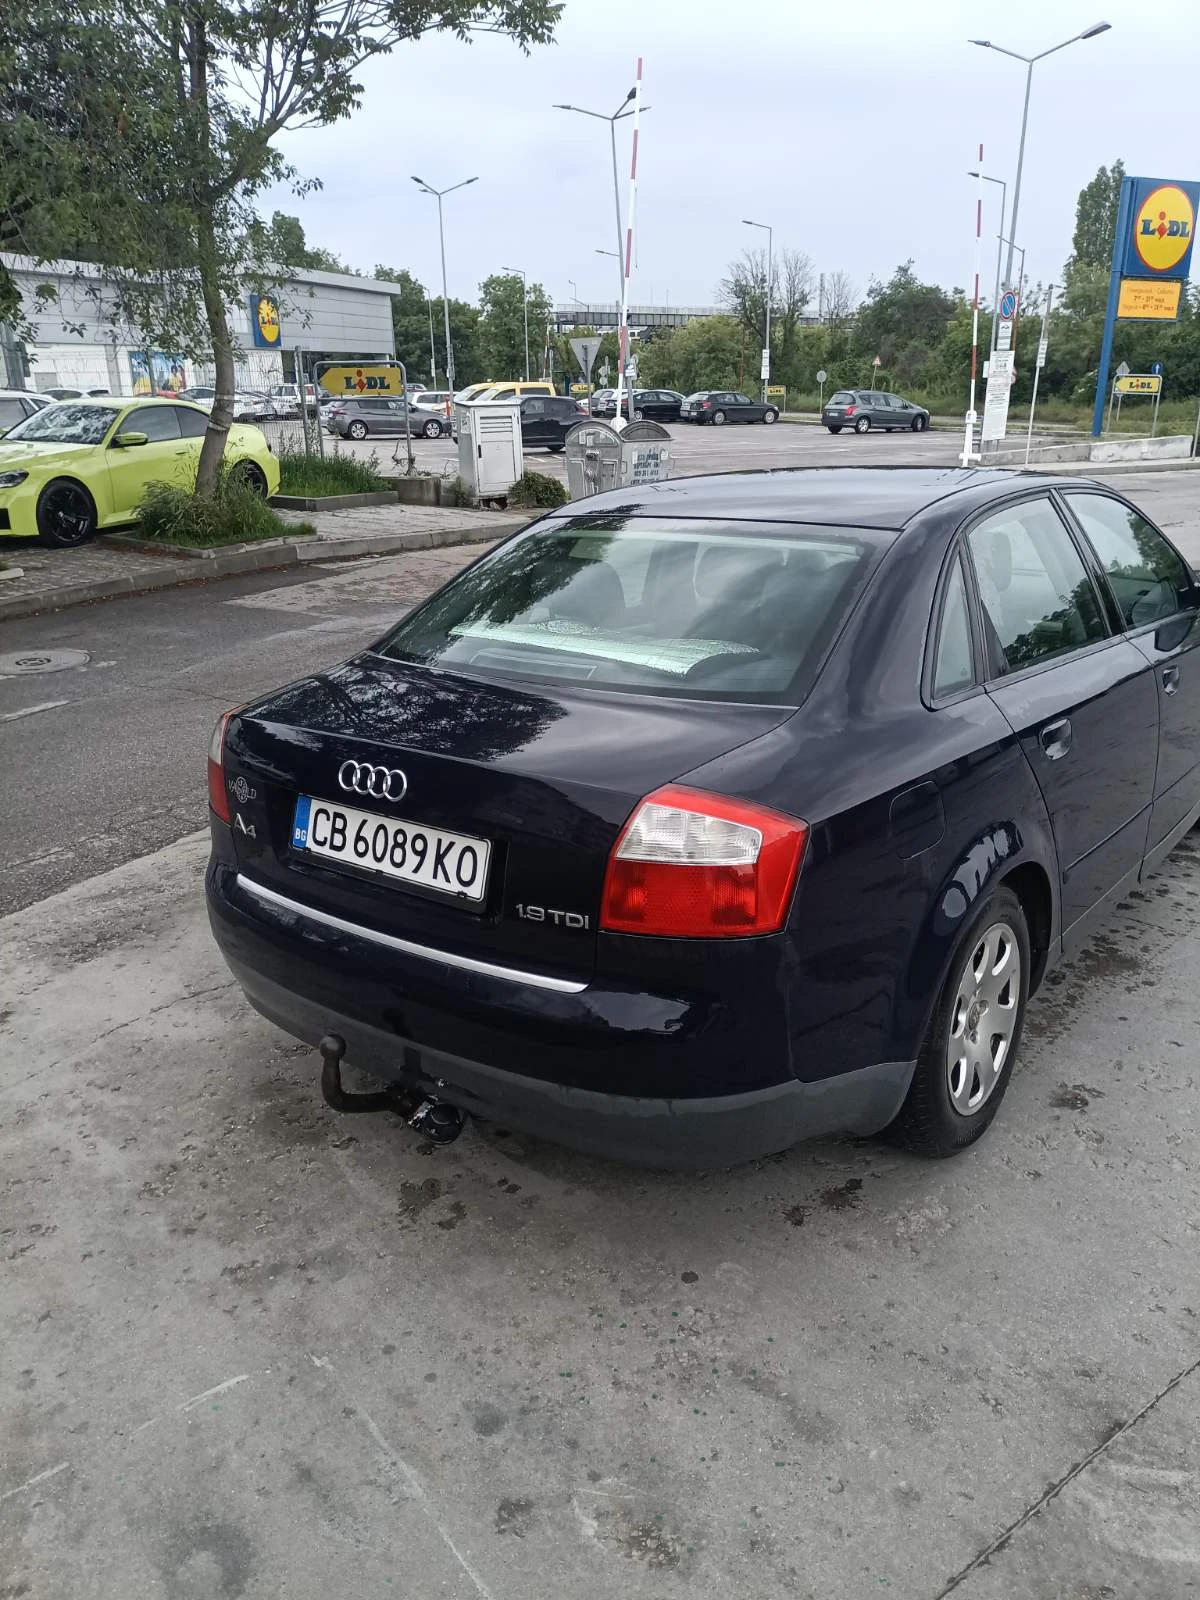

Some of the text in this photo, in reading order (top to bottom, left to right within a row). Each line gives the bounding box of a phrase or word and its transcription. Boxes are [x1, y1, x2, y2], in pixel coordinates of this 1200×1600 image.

[234, 812, 257, 839] A4
[295, 828, 307, 841] BG
[515, 903, 589, 930] 1.9 TDI
